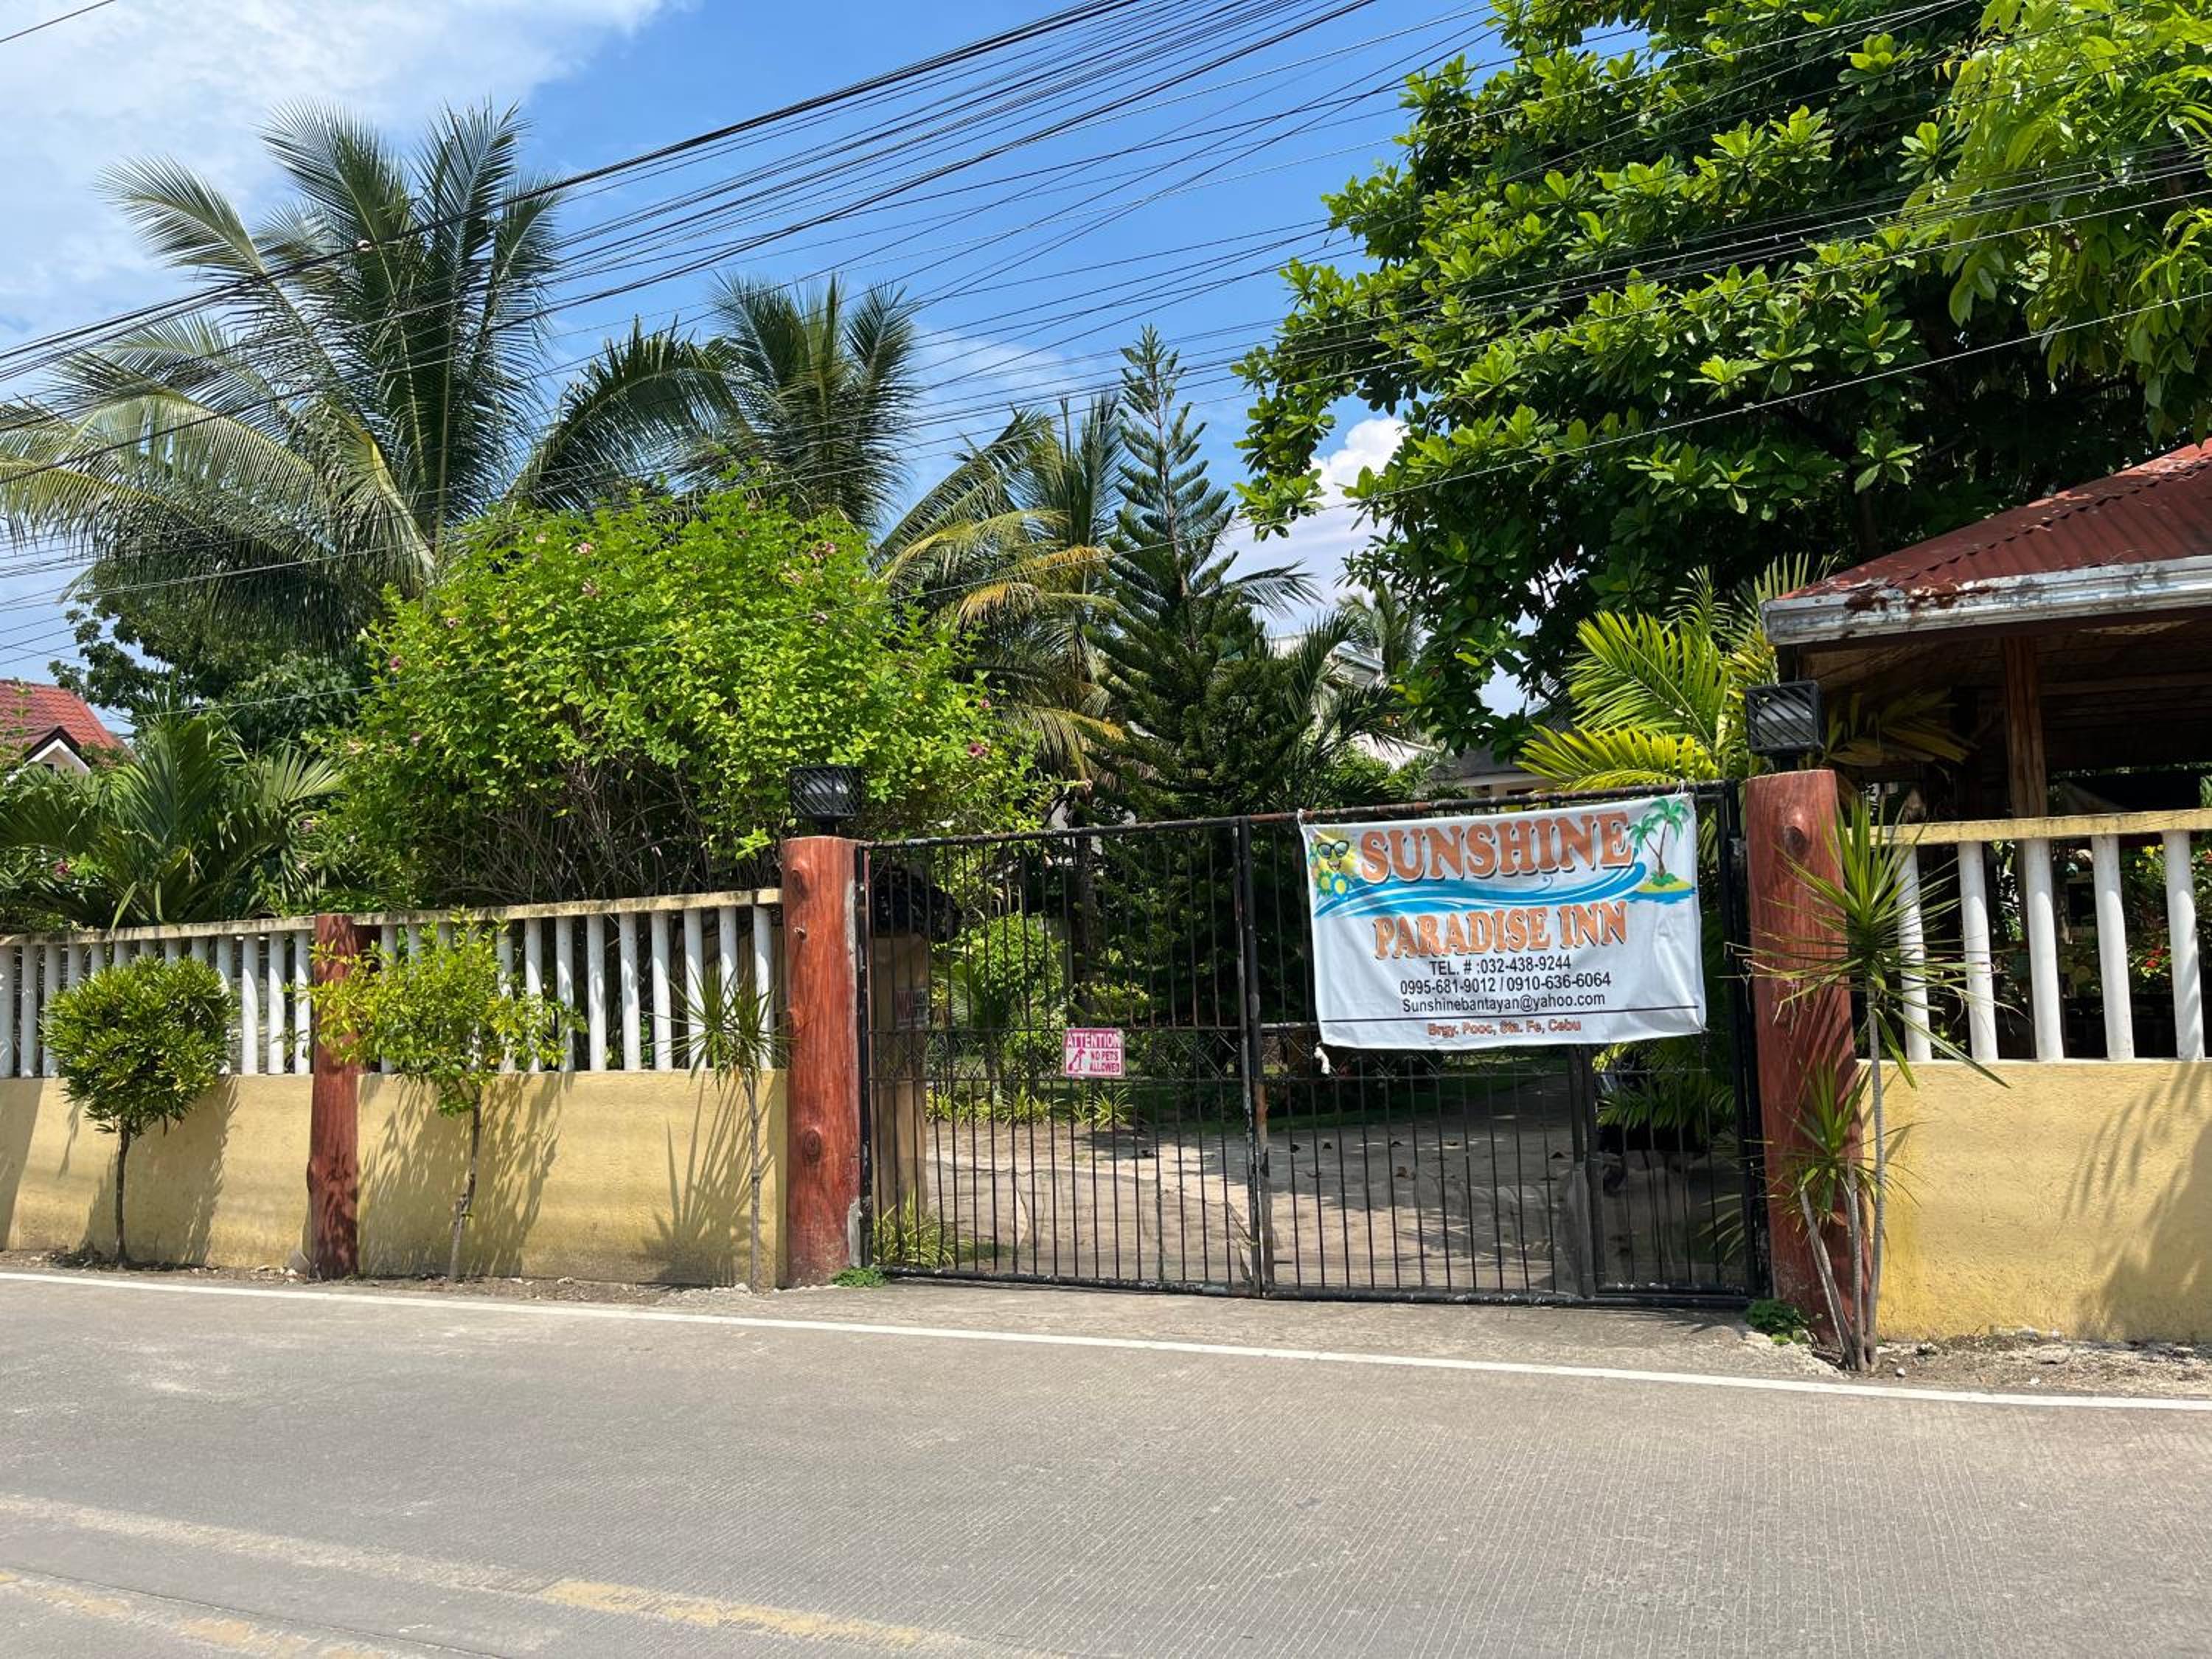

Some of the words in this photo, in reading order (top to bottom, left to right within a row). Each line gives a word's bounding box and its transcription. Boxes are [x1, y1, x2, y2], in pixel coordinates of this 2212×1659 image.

[1360, 812, 1633, 884] SUNSHINE
[1373, 907, 1550, 959] PARADISE
[1557, 901, 1628, 950] INN
[1429, 961, 1459, 975] TEL.
[1400, 977, 1496, 995] 0995-681-9012
[1506, 972, 1611, 991] 0910-636-6064
[1402, 993, 1605, 1013] Sunshinebantayan@yahoo.com
[1526, 1020, 1545, 1034] Fe,
[1548, 1018, 1581, 1032] Cebu
[1067, 1032, 1121, 1048] ATTENTION
[1091, 1051, 1100, 1060] NO
[1102, 1051, 1119, 1061] PETS
[1090, 1063, 1119, 1072] ALLOWED
